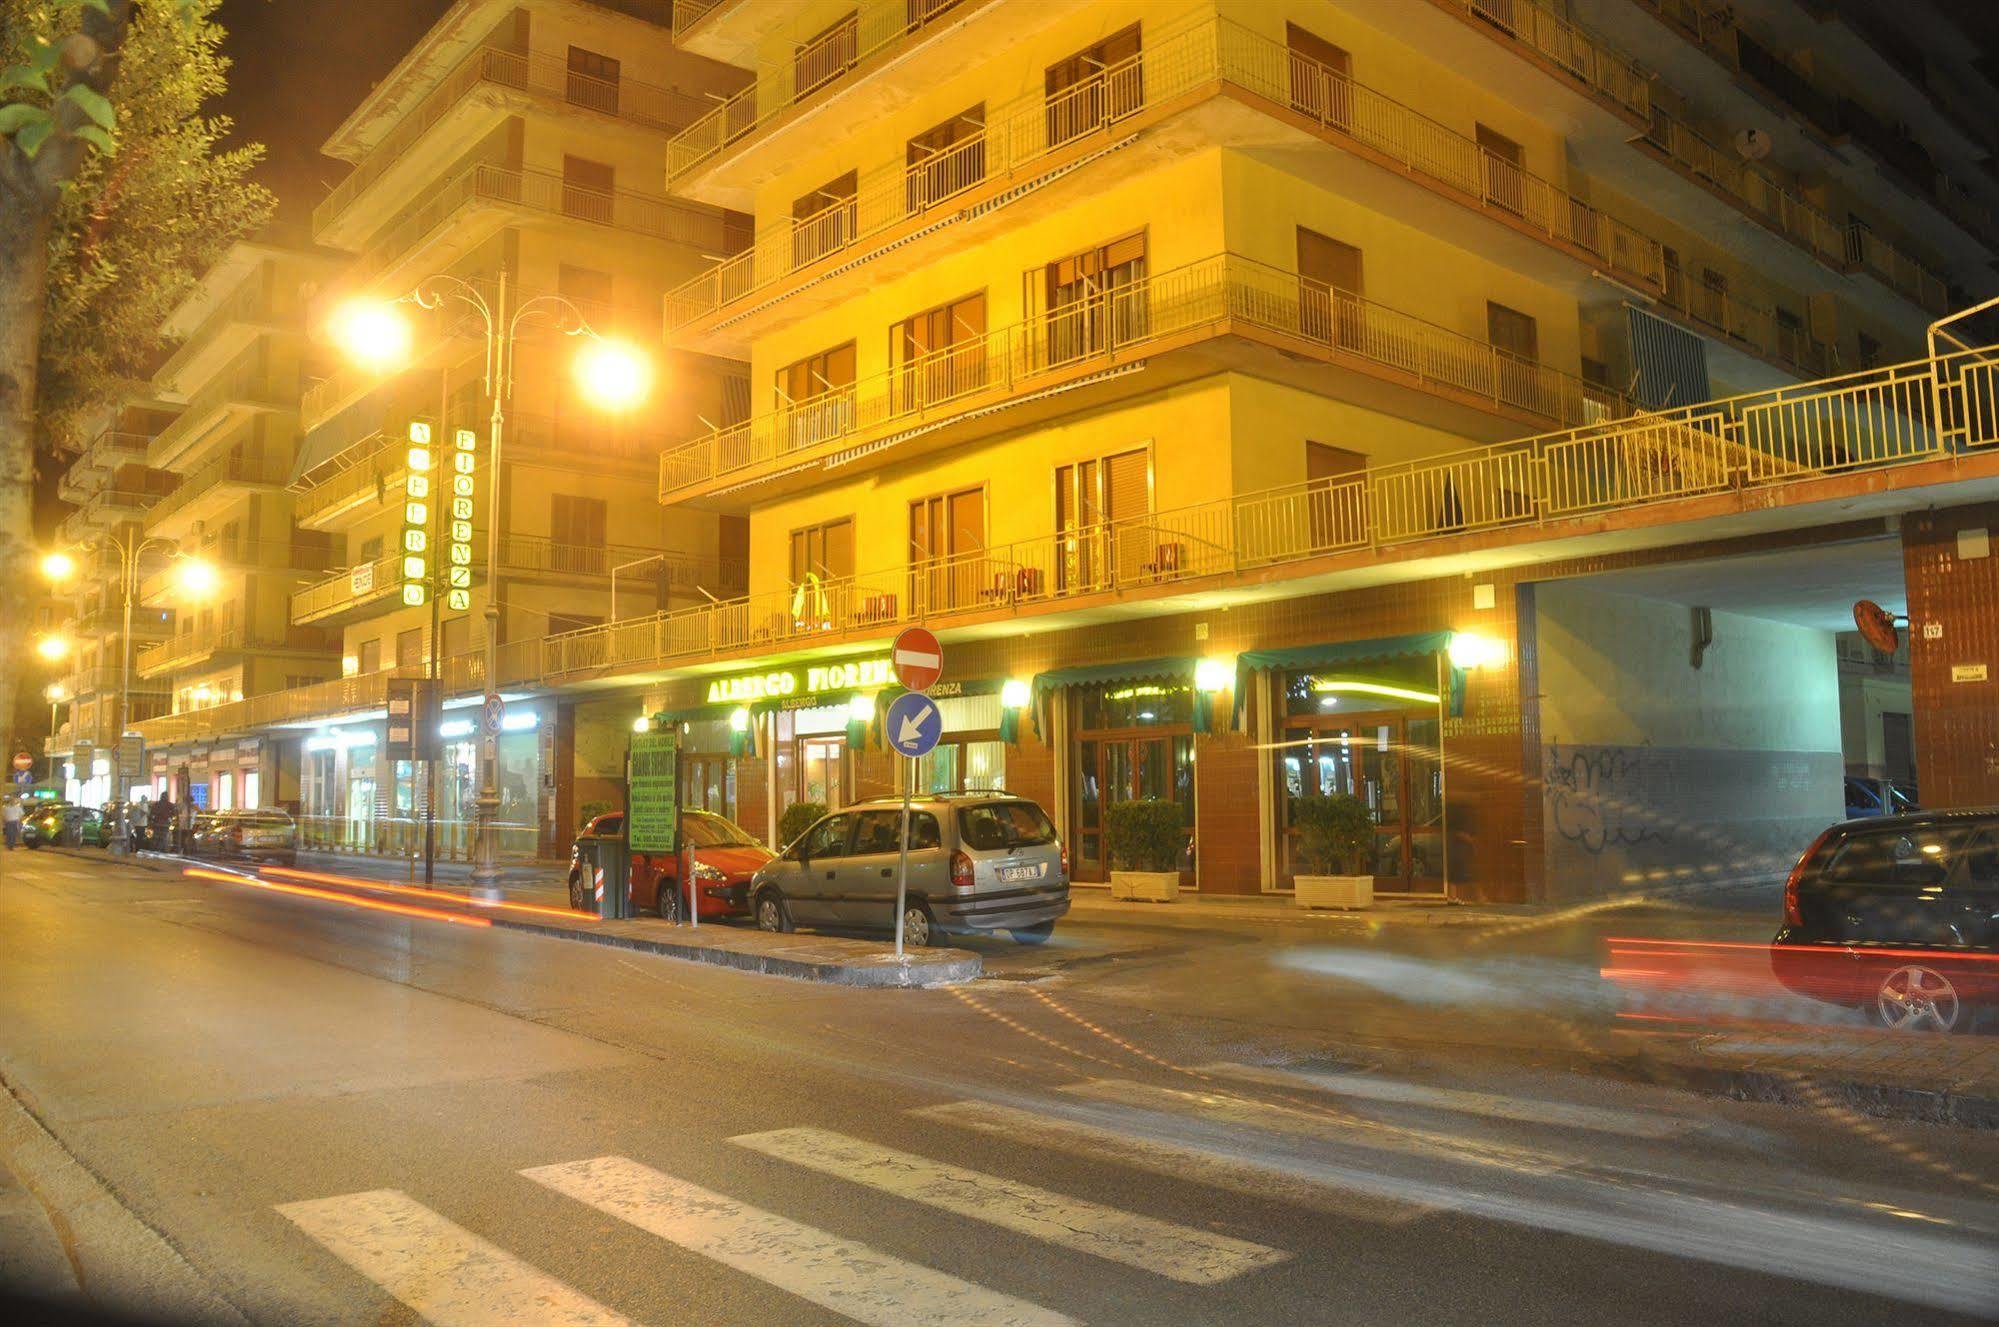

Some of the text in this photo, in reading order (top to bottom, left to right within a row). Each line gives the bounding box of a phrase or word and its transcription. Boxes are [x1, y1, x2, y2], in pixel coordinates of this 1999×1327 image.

[453, 432, 474, 607] FIORENZA
[706, 671, 795, 703] ALBERGO
[781, 696, 818, 712] ALBERGO
